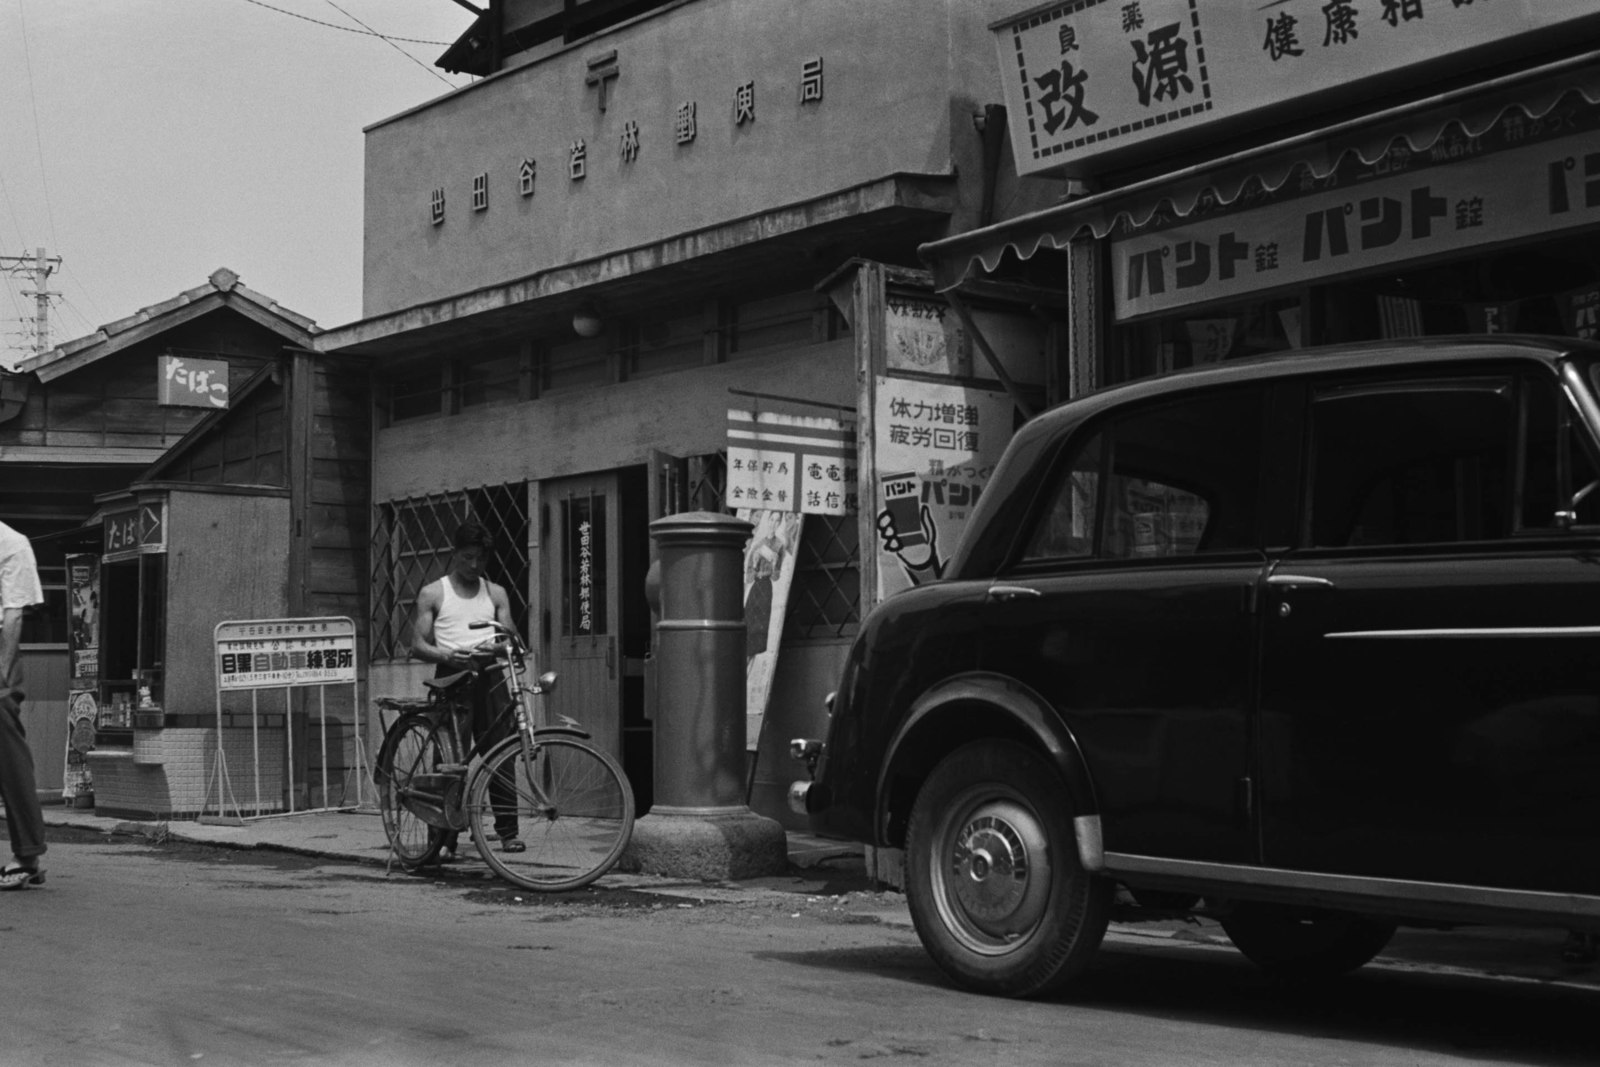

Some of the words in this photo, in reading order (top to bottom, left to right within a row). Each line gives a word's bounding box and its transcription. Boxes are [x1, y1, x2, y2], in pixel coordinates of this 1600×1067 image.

[1263, 0, 1474, 61] 健康相
[1034, 21, 1194, 136] 改源
[429, 56, 823, 226] 世田谷若林郵便局
[1303, 186, 1484, 263] パント錠
[1128, 232, 1279, 301] パント錠
[166, 358, 227, 407] たばこ
[889, 397, 979, 427] 体力増強
[889, 424, 979, 452] 疲労回復
[886, 481, 916, 497] パント
[222, 649, 353, 674] 目黒自動車練習所
